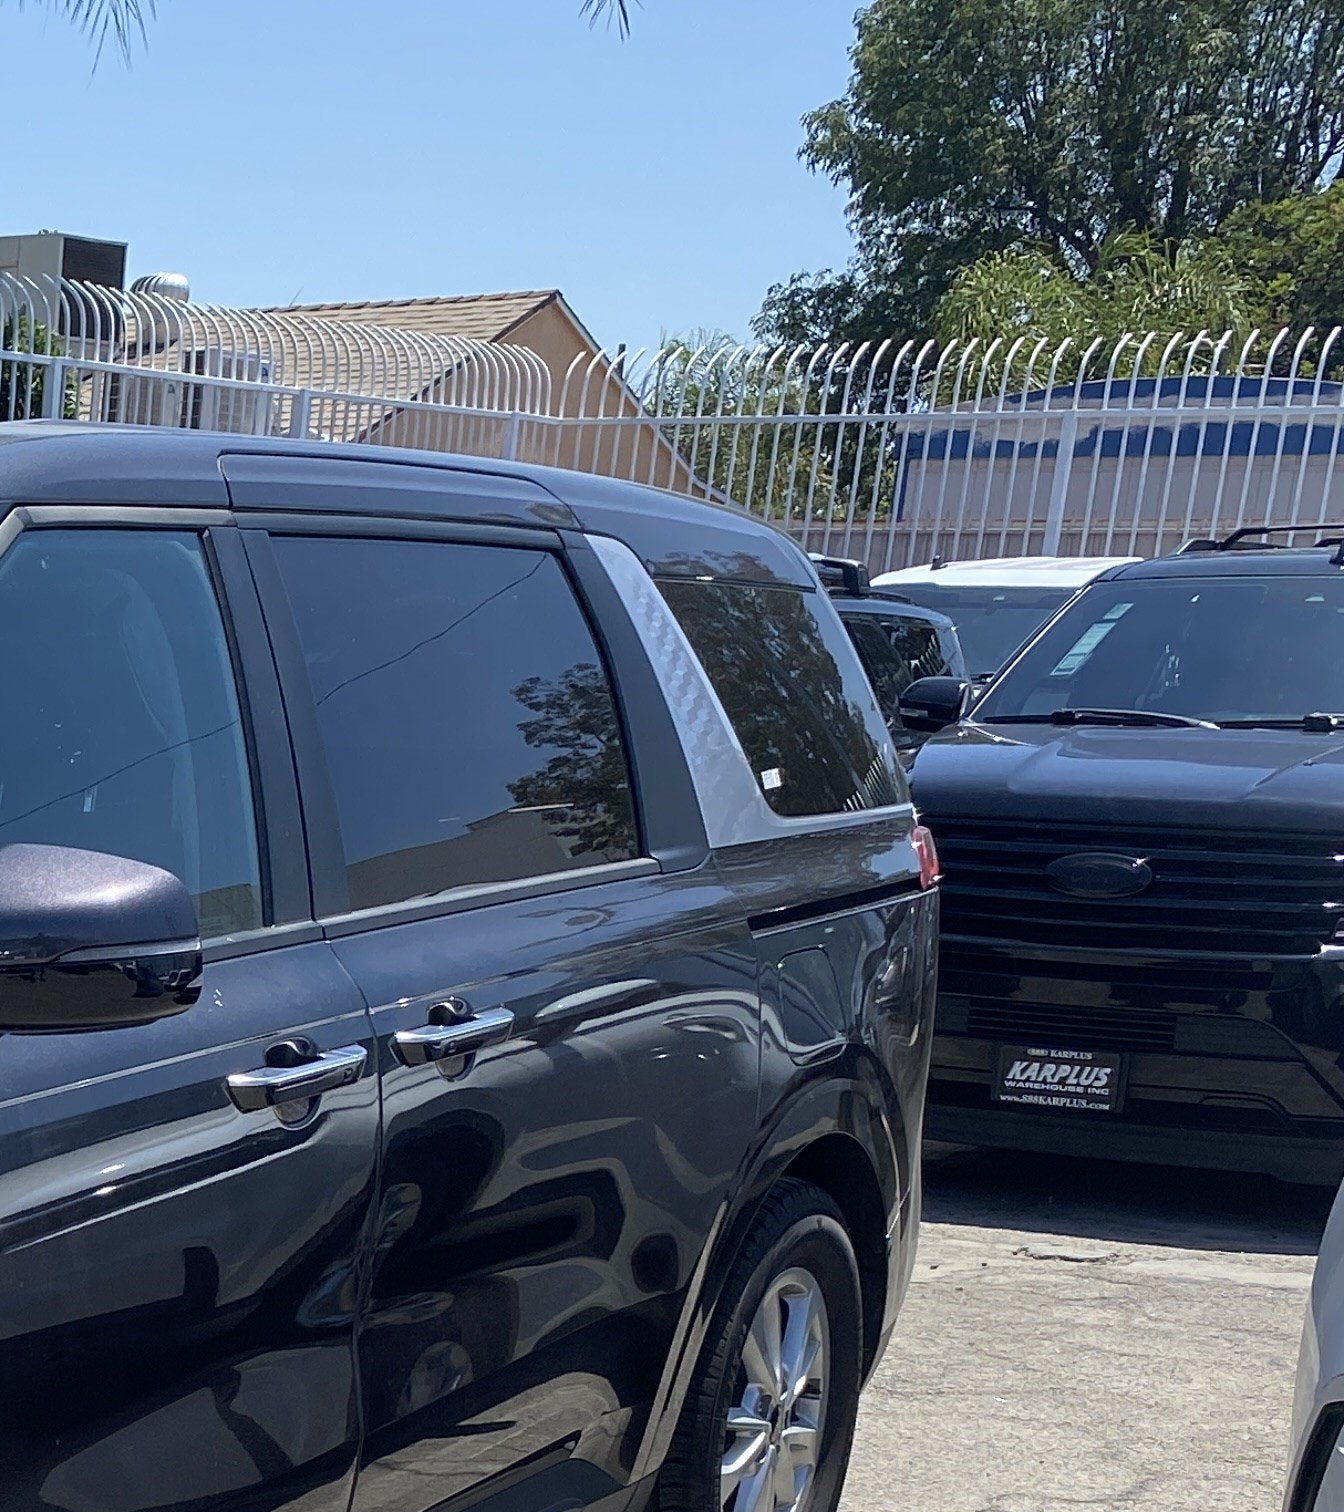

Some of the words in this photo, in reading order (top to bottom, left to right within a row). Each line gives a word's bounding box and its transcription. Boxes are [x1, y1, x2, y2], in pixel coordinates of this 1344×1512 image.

[1050, 1049, 1093, 1060] KARPLUS
[1006, 1060, 1113, 1087] KARPLUS
[1004, 1080, 1085, 1094] WAREHOUSE
[1087, 1087, 1111, 1095] INC
